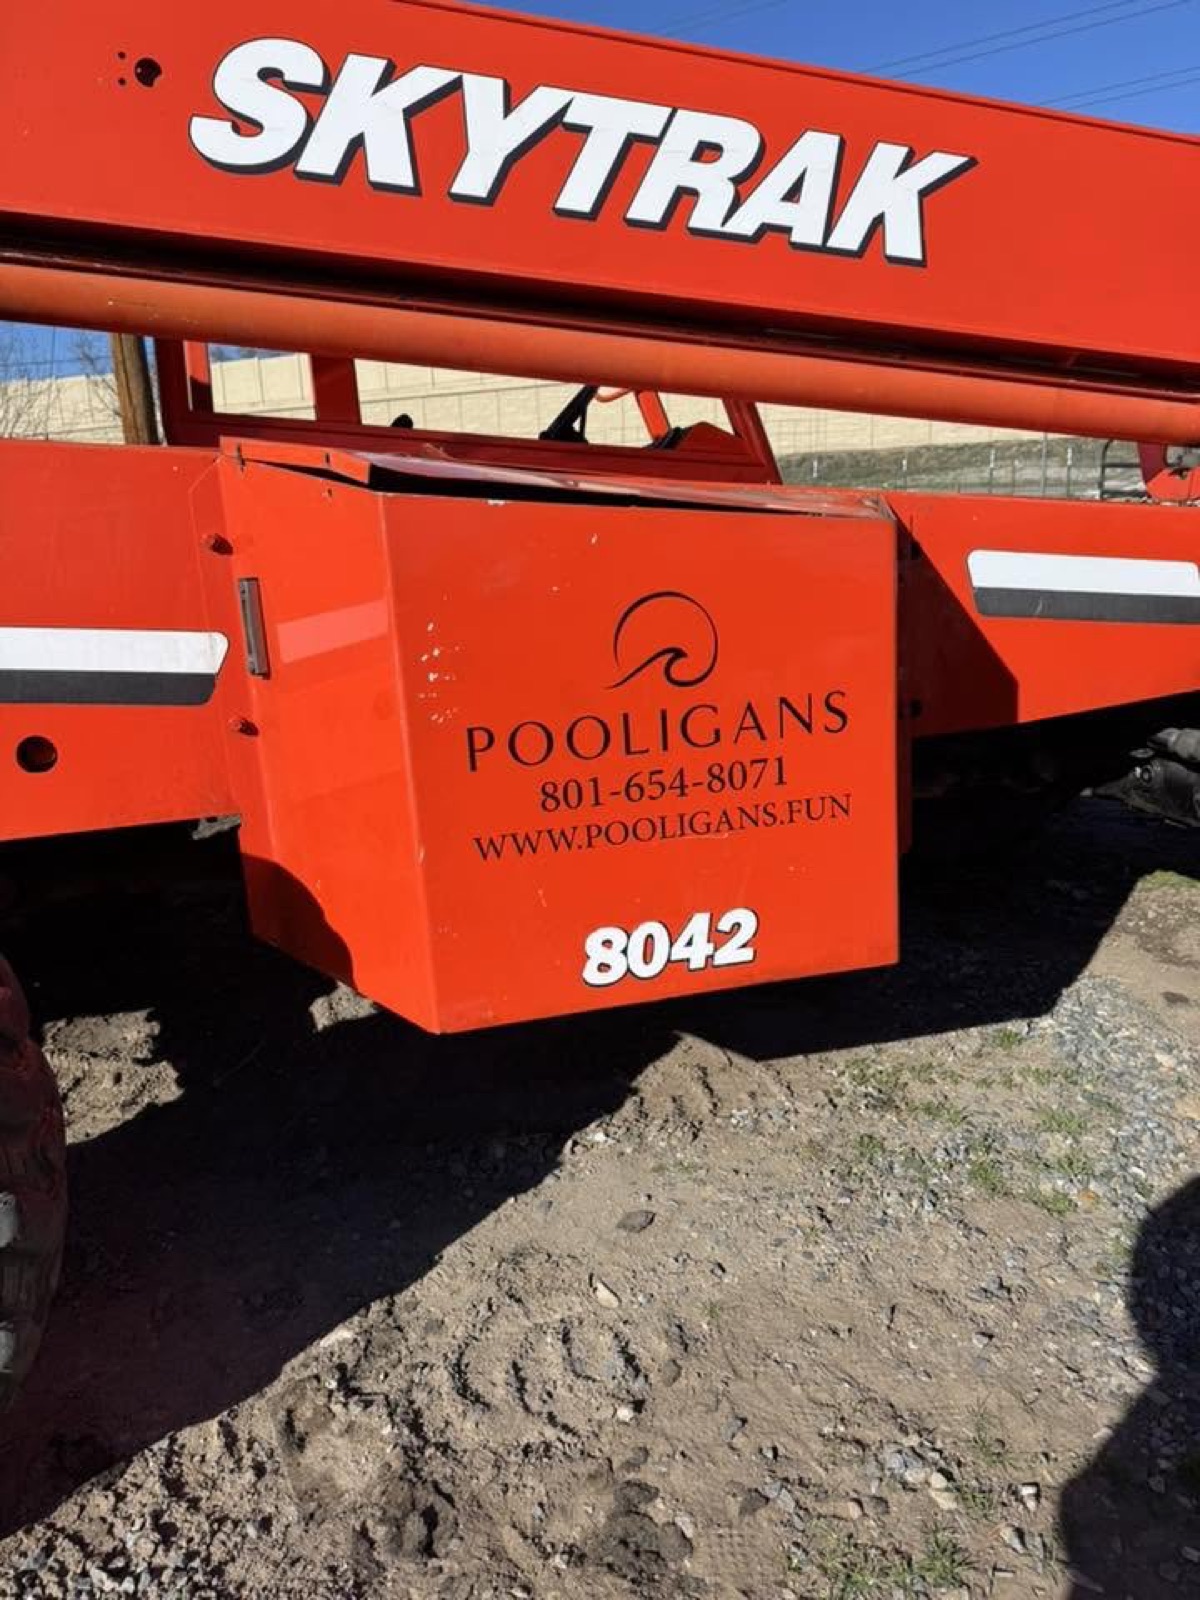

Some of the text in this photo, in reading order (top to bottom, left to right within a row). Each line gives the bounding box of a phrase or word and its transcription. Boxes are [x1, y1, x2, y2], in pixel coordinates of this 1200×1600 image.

[189, 37, 977, 267] SKYTRAK
[467, 690, 850, 772] POOLIGANS
[540, 757, 788, 812] 801-654-8071
[473, 793, 852, 861] WWW.POOLIGANS.FUN
[581, 907, 759, 987] 8042
